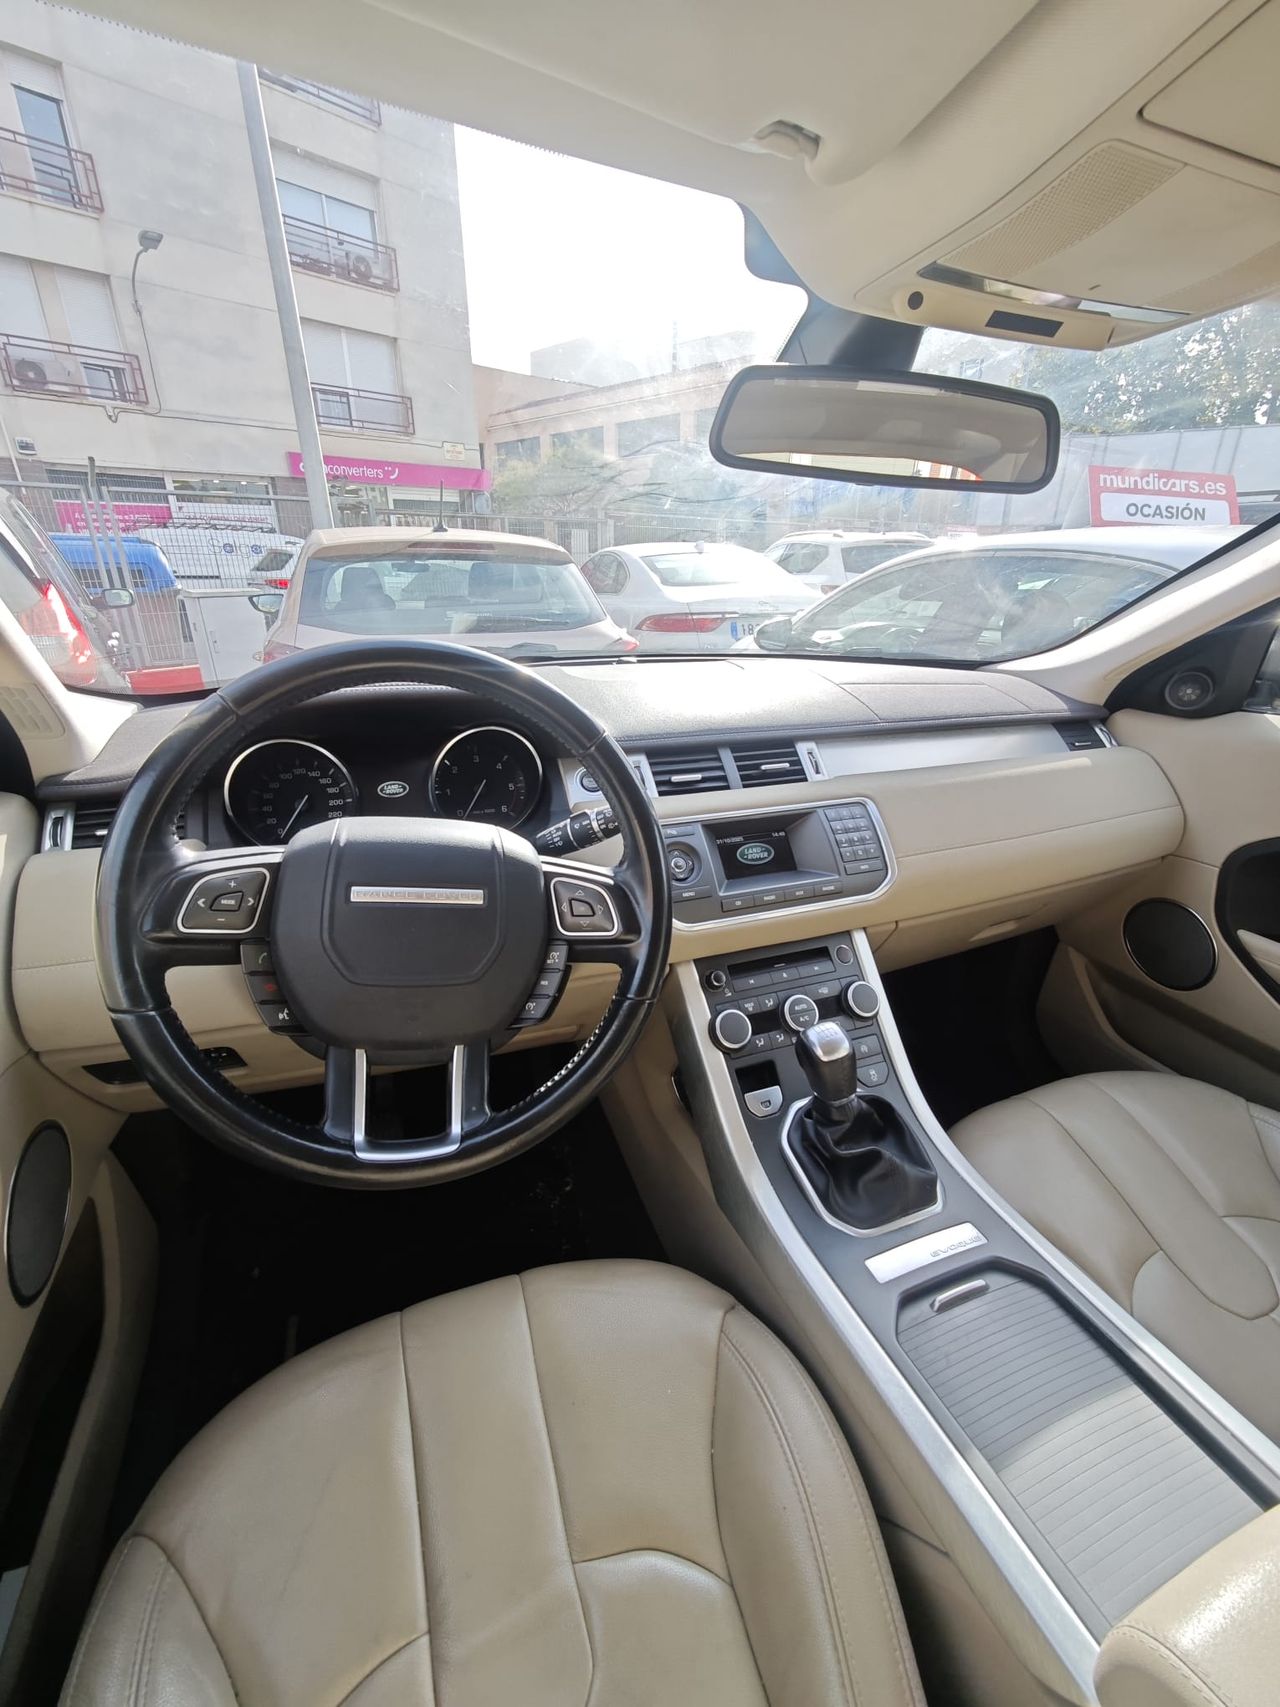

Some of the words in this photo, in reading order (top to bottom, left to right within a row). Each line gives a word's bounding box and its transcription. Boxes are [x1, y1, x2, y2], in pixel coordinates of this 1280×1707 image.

[1099, 473, 1227, 495] mundicars.es
[1125, 503, 1206, 521] OCASIÓN
[473, 755, 479, 763] 3
[452, 766, 458, 774] 2
[508, 783, 515, 791] 5
[501, 804, 508, 813] 6
